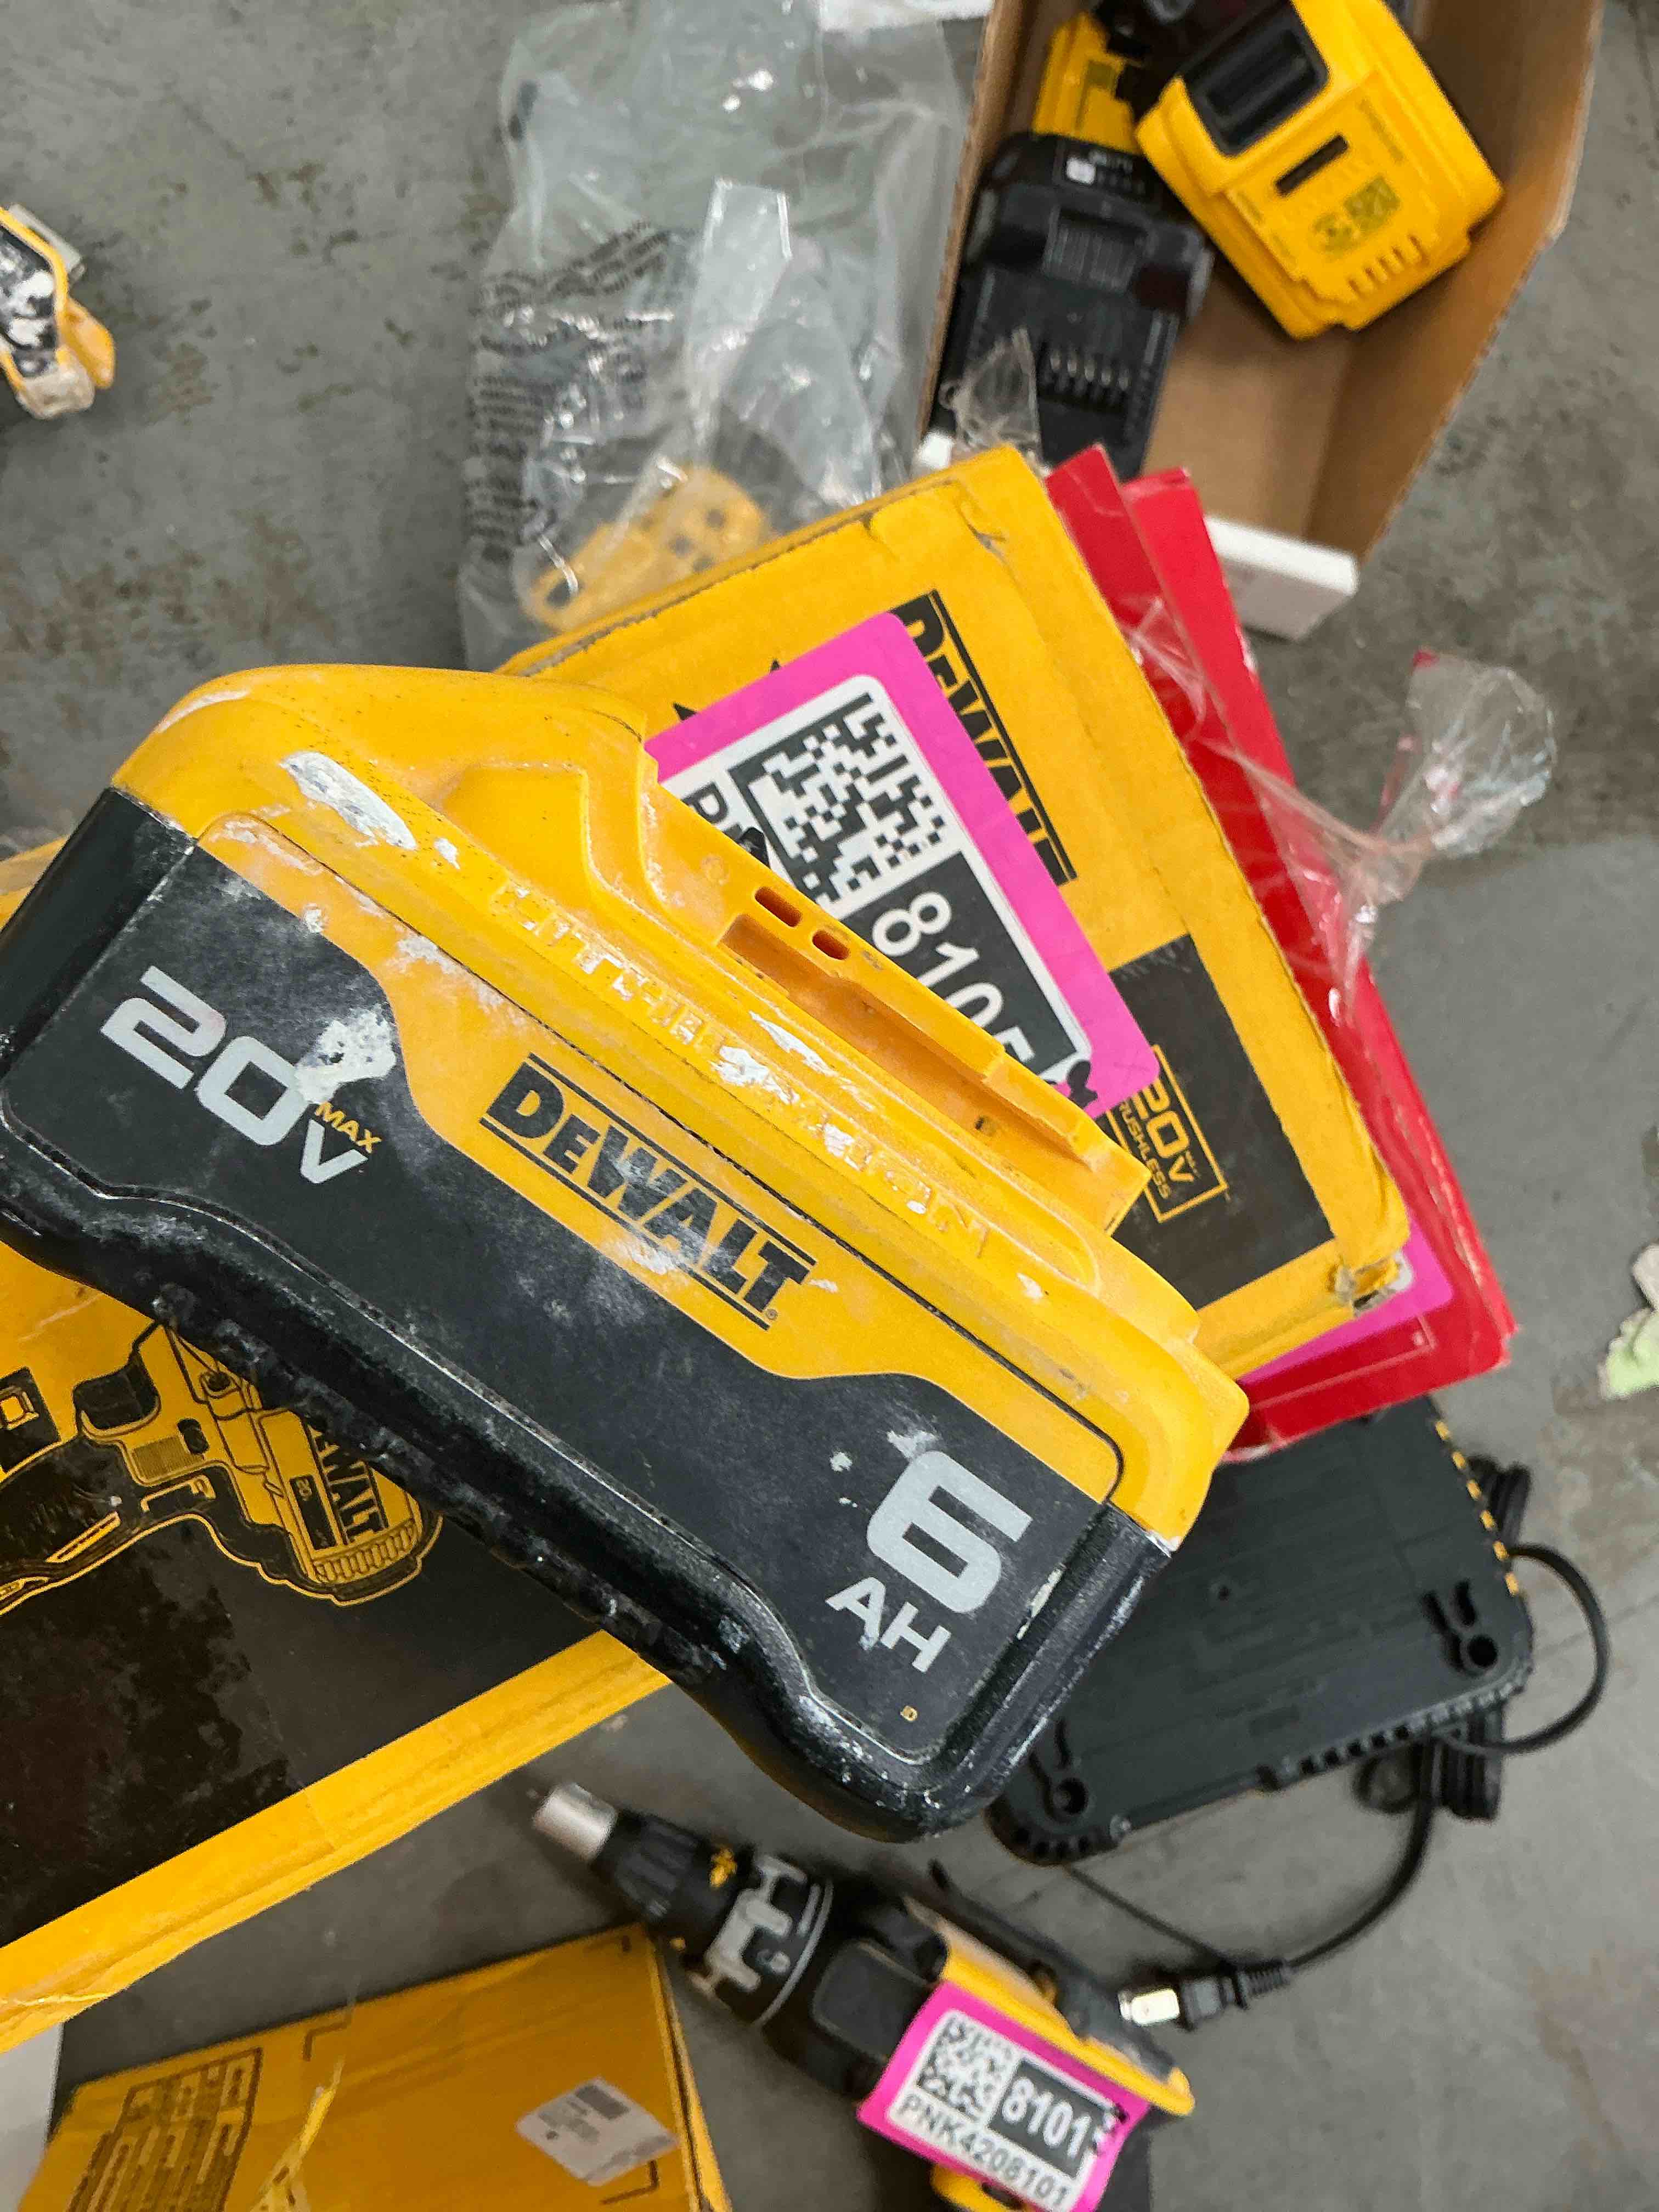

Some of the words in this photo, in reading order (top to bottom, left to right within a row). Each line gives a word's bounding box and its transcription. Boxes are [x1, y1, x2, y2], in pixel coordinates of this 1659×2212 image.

[872, 891, 1036, 1063] 810
[314, 1101, 382, 1154] MAX
[1118, 1099, 1173, 1200] RUSHLESS
[866, 1451, 1034, 1613] 6
[825, 1576, 952, 1674] AH
[1001, 2076, 1092, 2160] 8101
